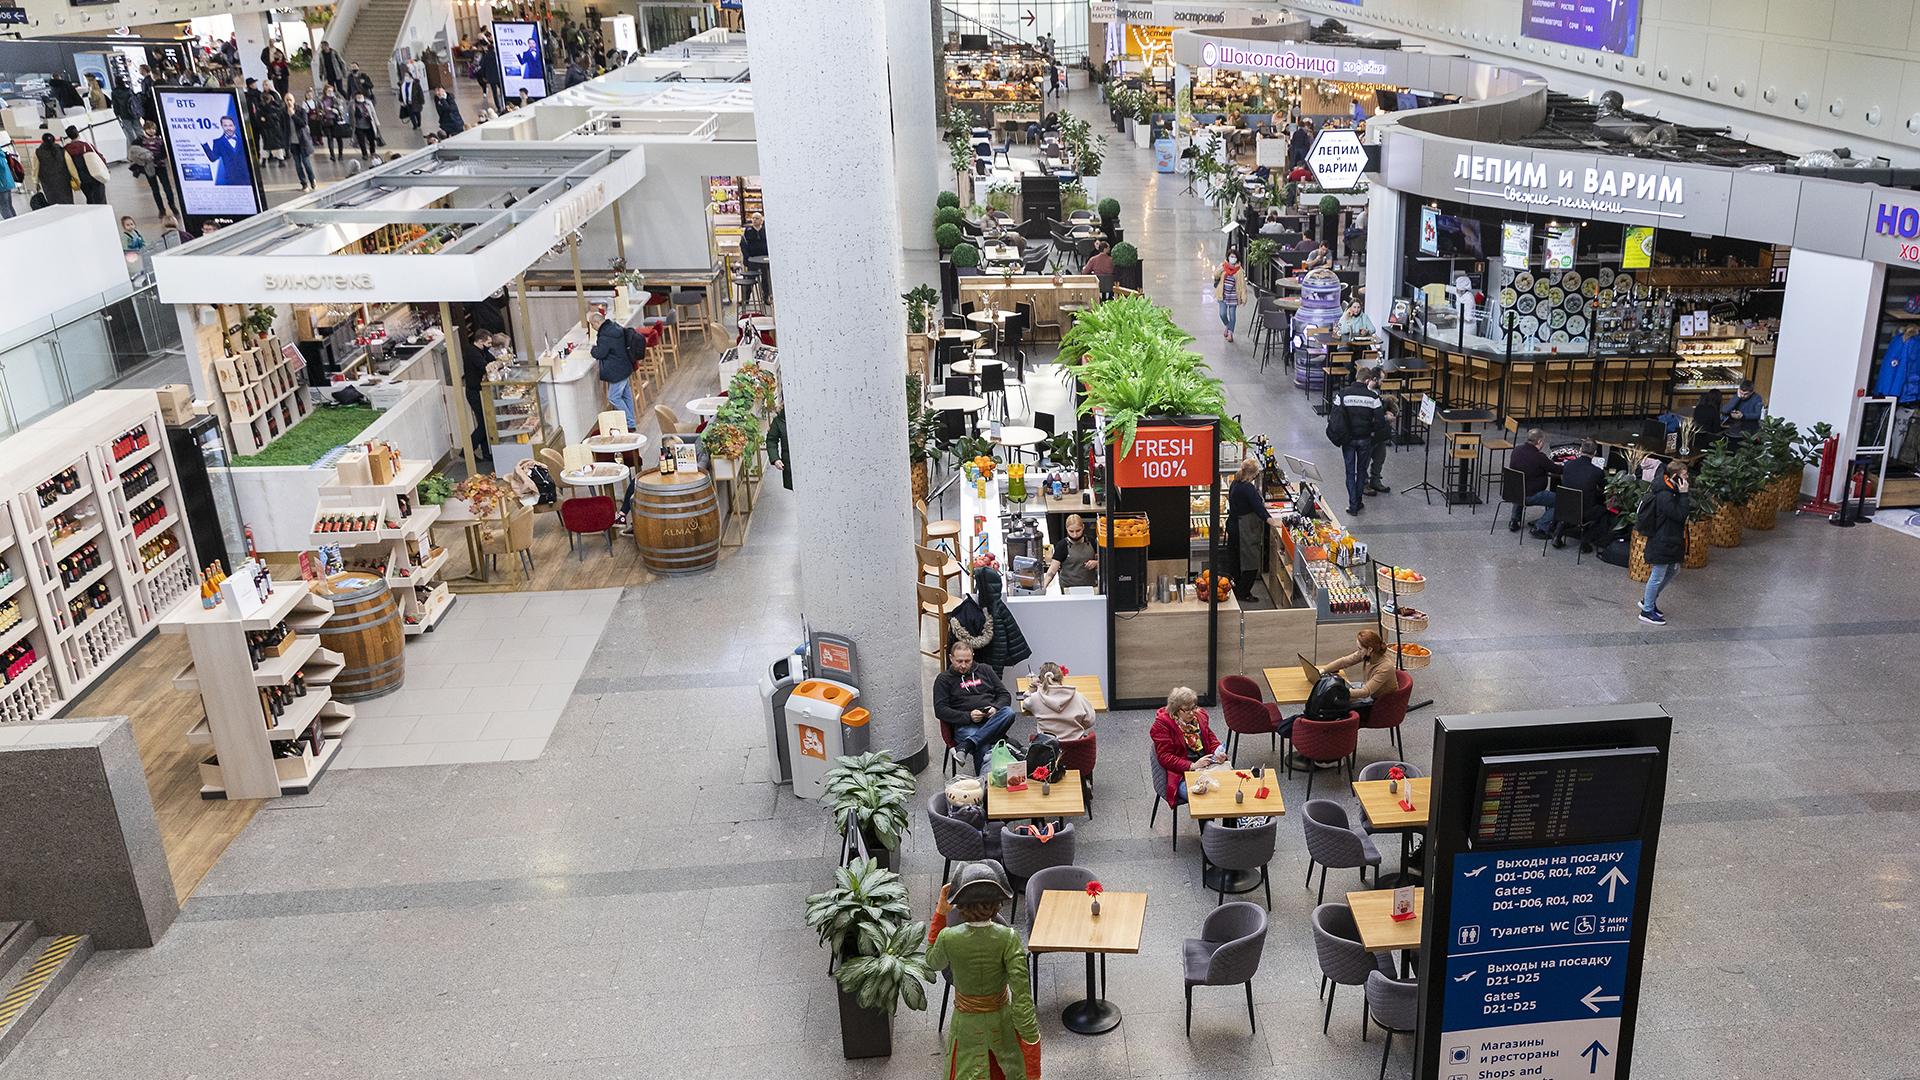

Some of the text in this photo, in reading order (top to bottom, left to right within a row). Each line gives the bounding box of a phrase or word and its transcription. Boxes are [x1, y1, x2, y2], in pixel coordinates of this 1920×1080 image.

[1220, 47, 1336, 74] Шоколадница
[176, 99, 196, 108] ВТБ
[1318, 145, 1360, 155] ЛЕПИМ
[1318, 162, 1358, 173] ВАРИМ
[1454, 153, 1683, 205] ЛЕПИМ и ВАРИМ
[1504, 184, 1624, 213] Свежие пельмени
[1135, 438, 1193, 457] FRESH
[1141, 459, 1187, 478] 100%
[663, 528, 691, 536] ALMA
[1497, 851, 1624, 870] Выходы на посадку
[1495, 865, 1596, 882] D01-D06, R01, R02
[1495, 885, 1532, 897] Gates
[1493, 893, 1593, 911] D01-D06, R01, R02
[1490, 921, 1570, 938] Туалеты WC
[1599, 924, 1625, 933] 3 min
[1487, 955, 1612, 974] Выходы на посадку
[1486, 973, 1540, 986] D21-D25
[1484, 991, 1520, 1003] Gates
[1483, 1001, 1537, 1015] D21-D25
[1481, 1037, 1544, 1051] Магазины
[1491, 1050, 1560, 1064] рестораны
[1479, 1065, 1543, 1079] Shops and
